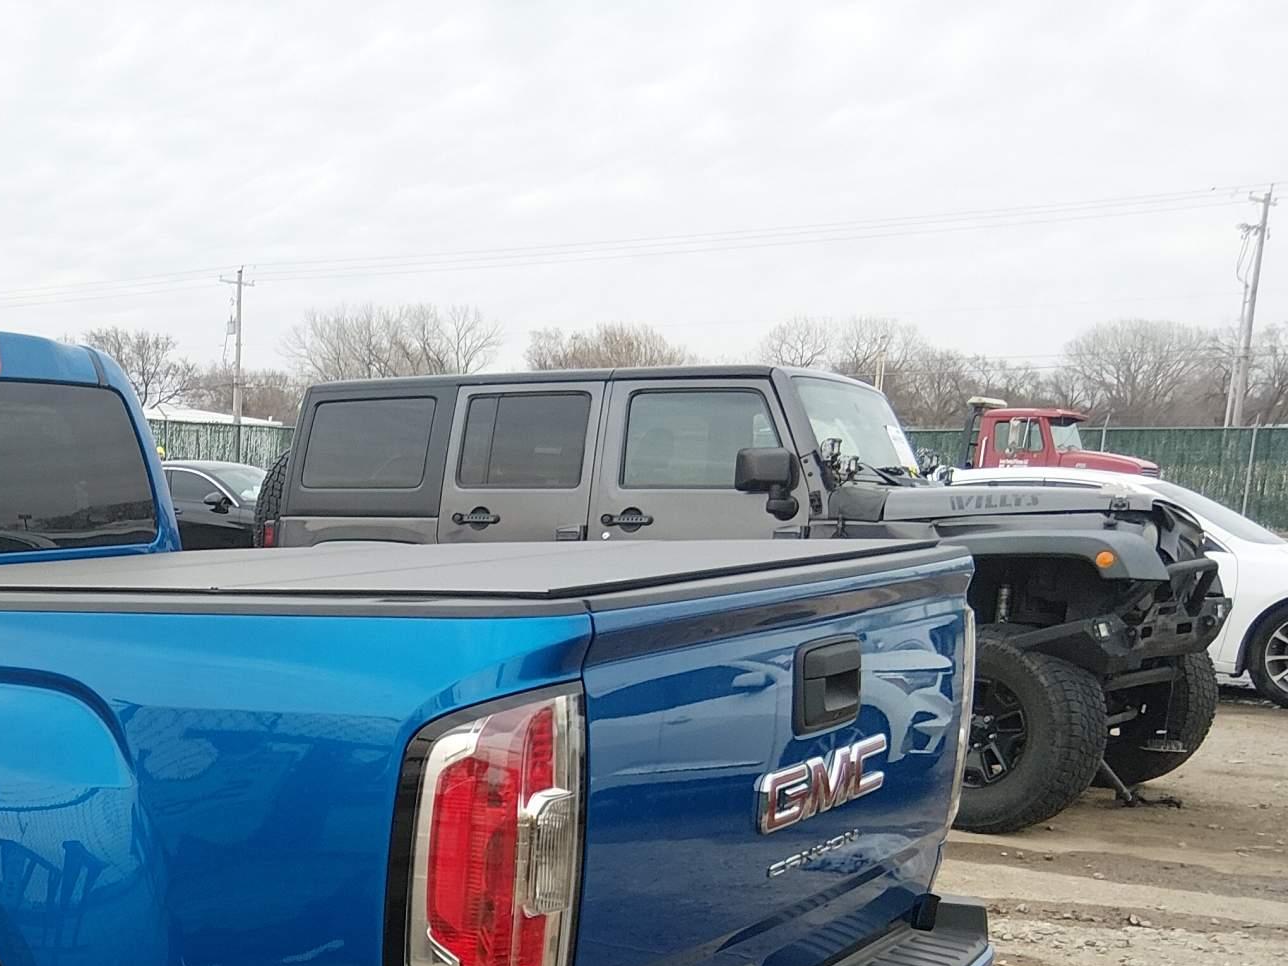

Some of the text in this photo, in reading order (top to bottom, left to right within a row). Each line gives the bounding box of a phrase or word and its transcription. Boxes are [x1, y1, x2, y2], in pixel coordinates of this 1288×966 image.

[949, 493, 1040, 511] WILLYS
[753, 732, 888, 835] GMC
[766, 828, 860, 878] CANYON
